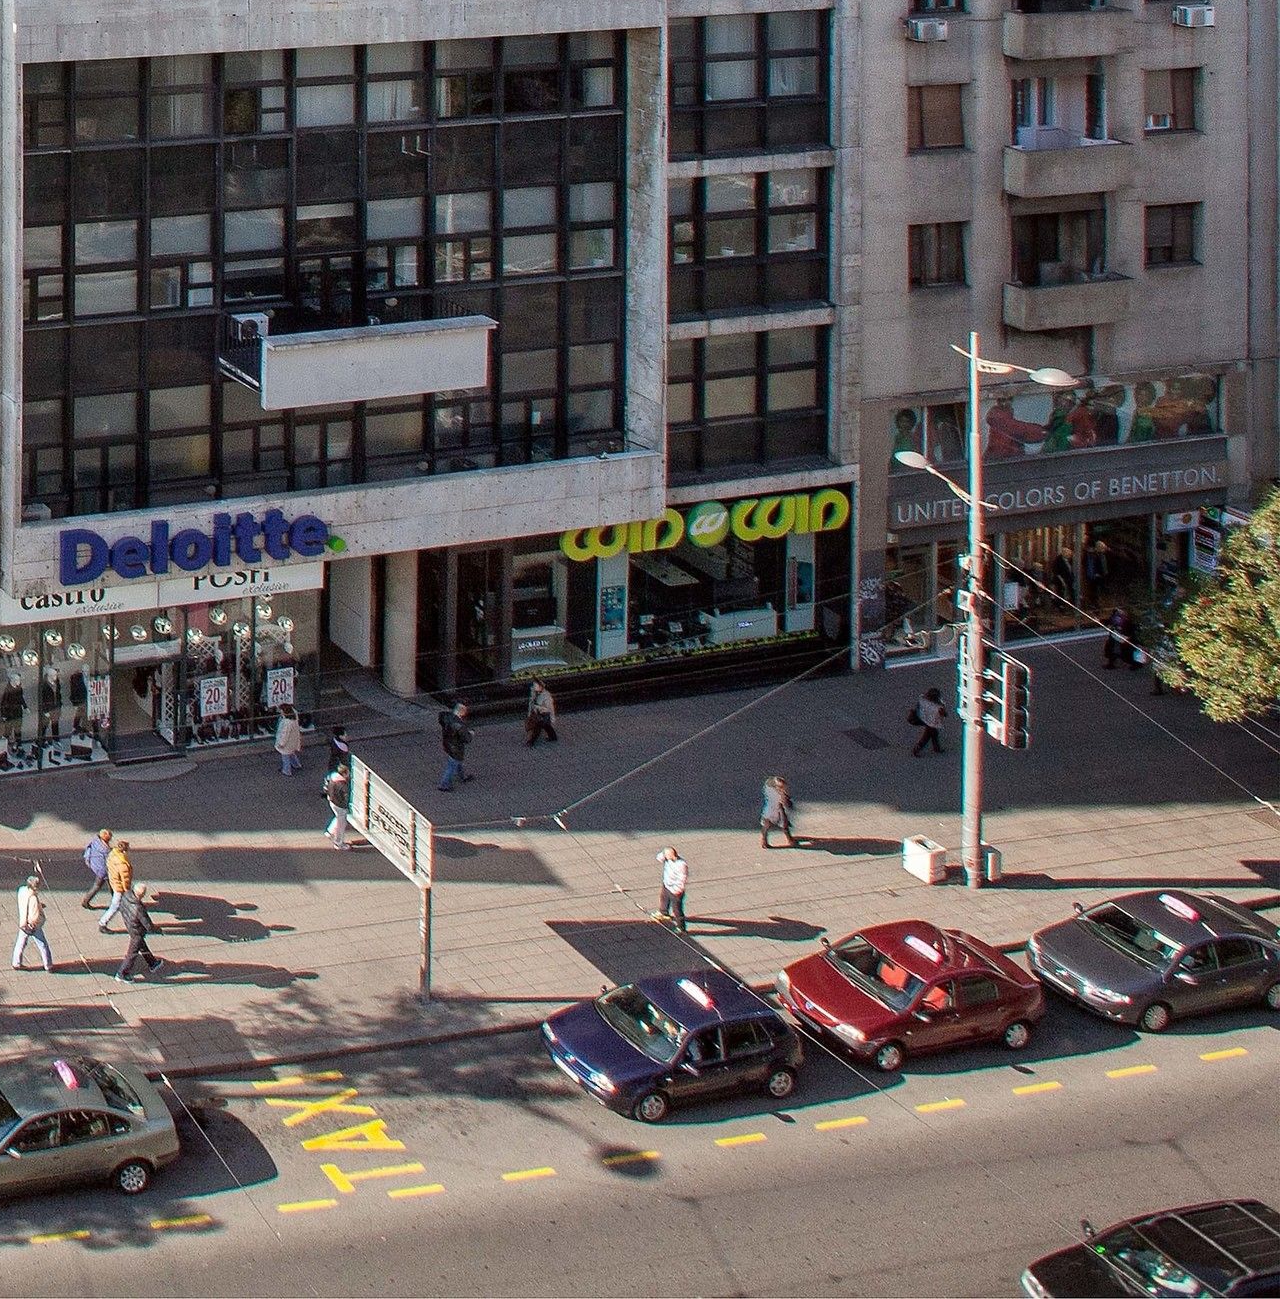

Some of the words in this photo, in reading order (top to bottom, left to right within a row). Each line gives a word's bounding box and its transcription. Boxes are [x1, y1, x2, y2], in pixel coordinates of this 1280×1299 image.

[897, 499, 970, 523] UNITE
[986, 485, 1066, 511] COLORS
[1074, 480, 1102, 501] OF
[252, 1070, 427, 1194] TAXI
